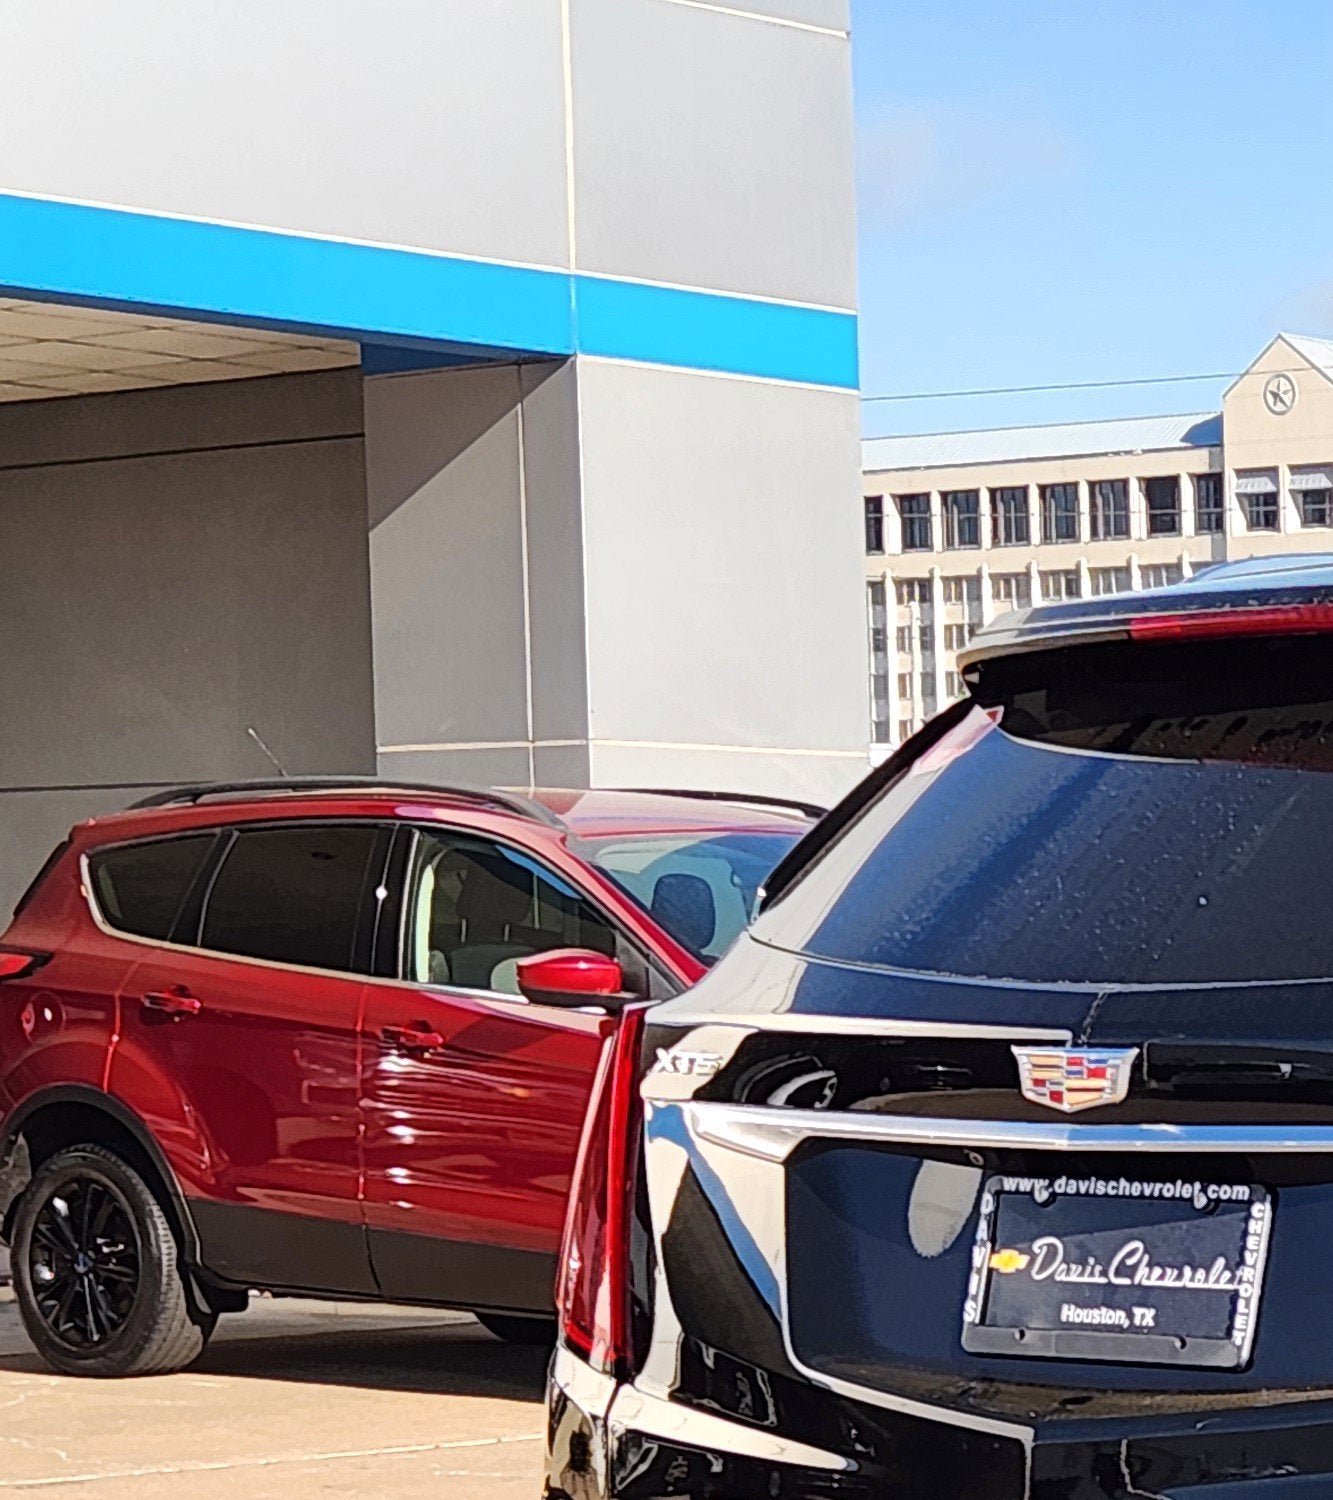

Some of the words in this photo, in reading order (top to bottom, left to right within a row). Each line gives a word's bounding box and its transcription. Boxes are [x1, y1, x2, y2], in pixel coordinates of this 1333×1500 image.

[1031, 1236, 1109, 1283] Davis
[1061, 1303, 1130, 1329] Houston,
[1132, 1306, 1156, 1328] TX
